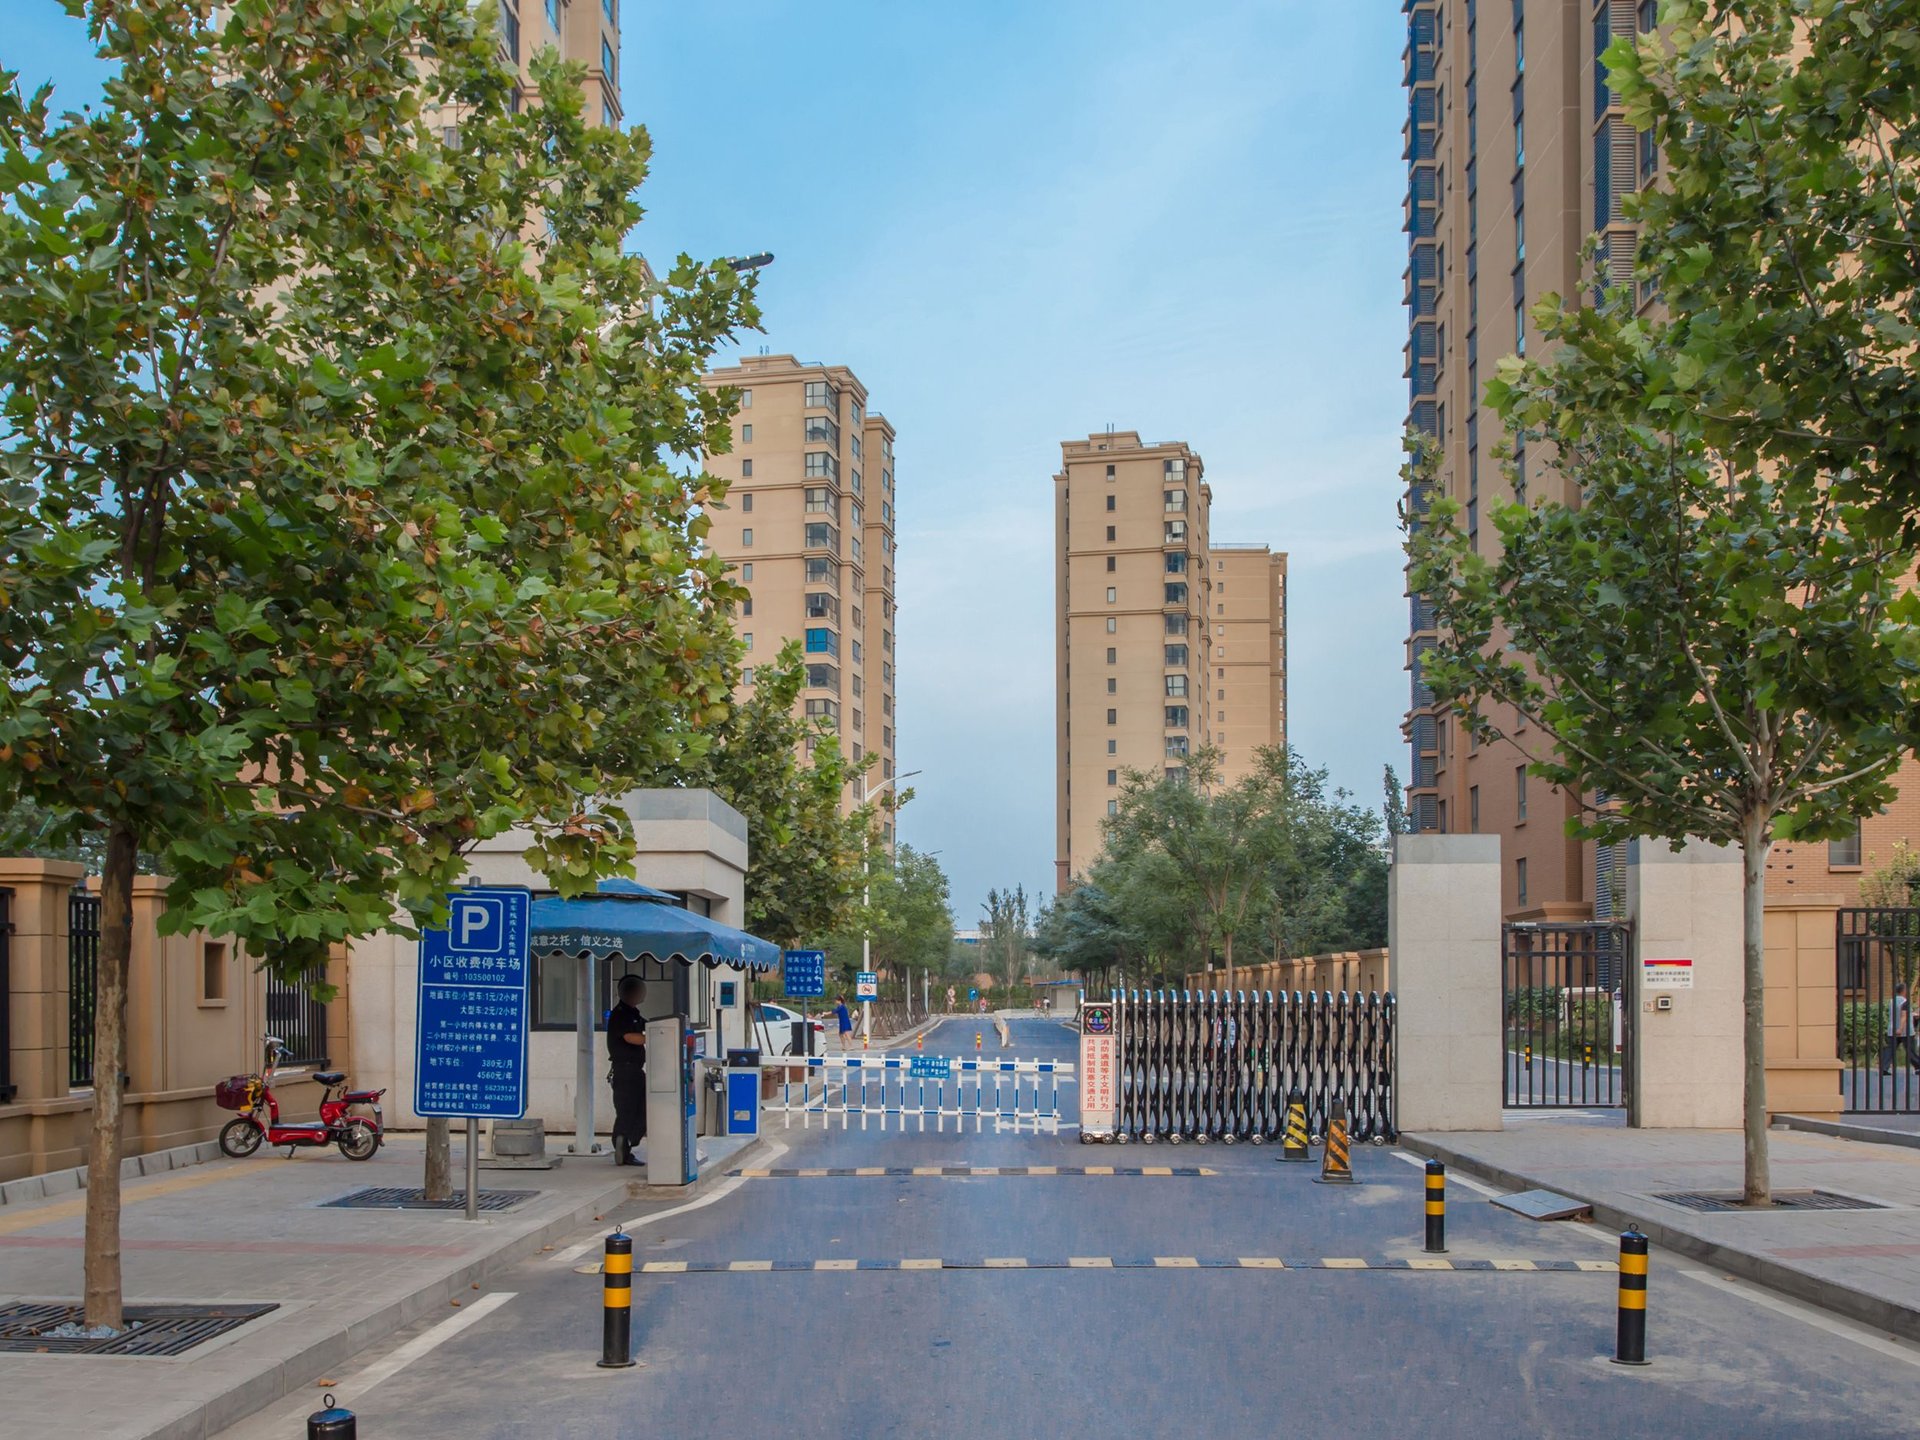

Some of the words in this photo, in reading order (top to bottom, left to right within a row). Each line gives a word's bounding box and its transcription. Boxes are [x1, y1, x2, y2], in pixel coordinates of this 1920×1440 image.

[461, 905, 490, 944] P
[430, 955, 521, 970] 小区收费停车场
